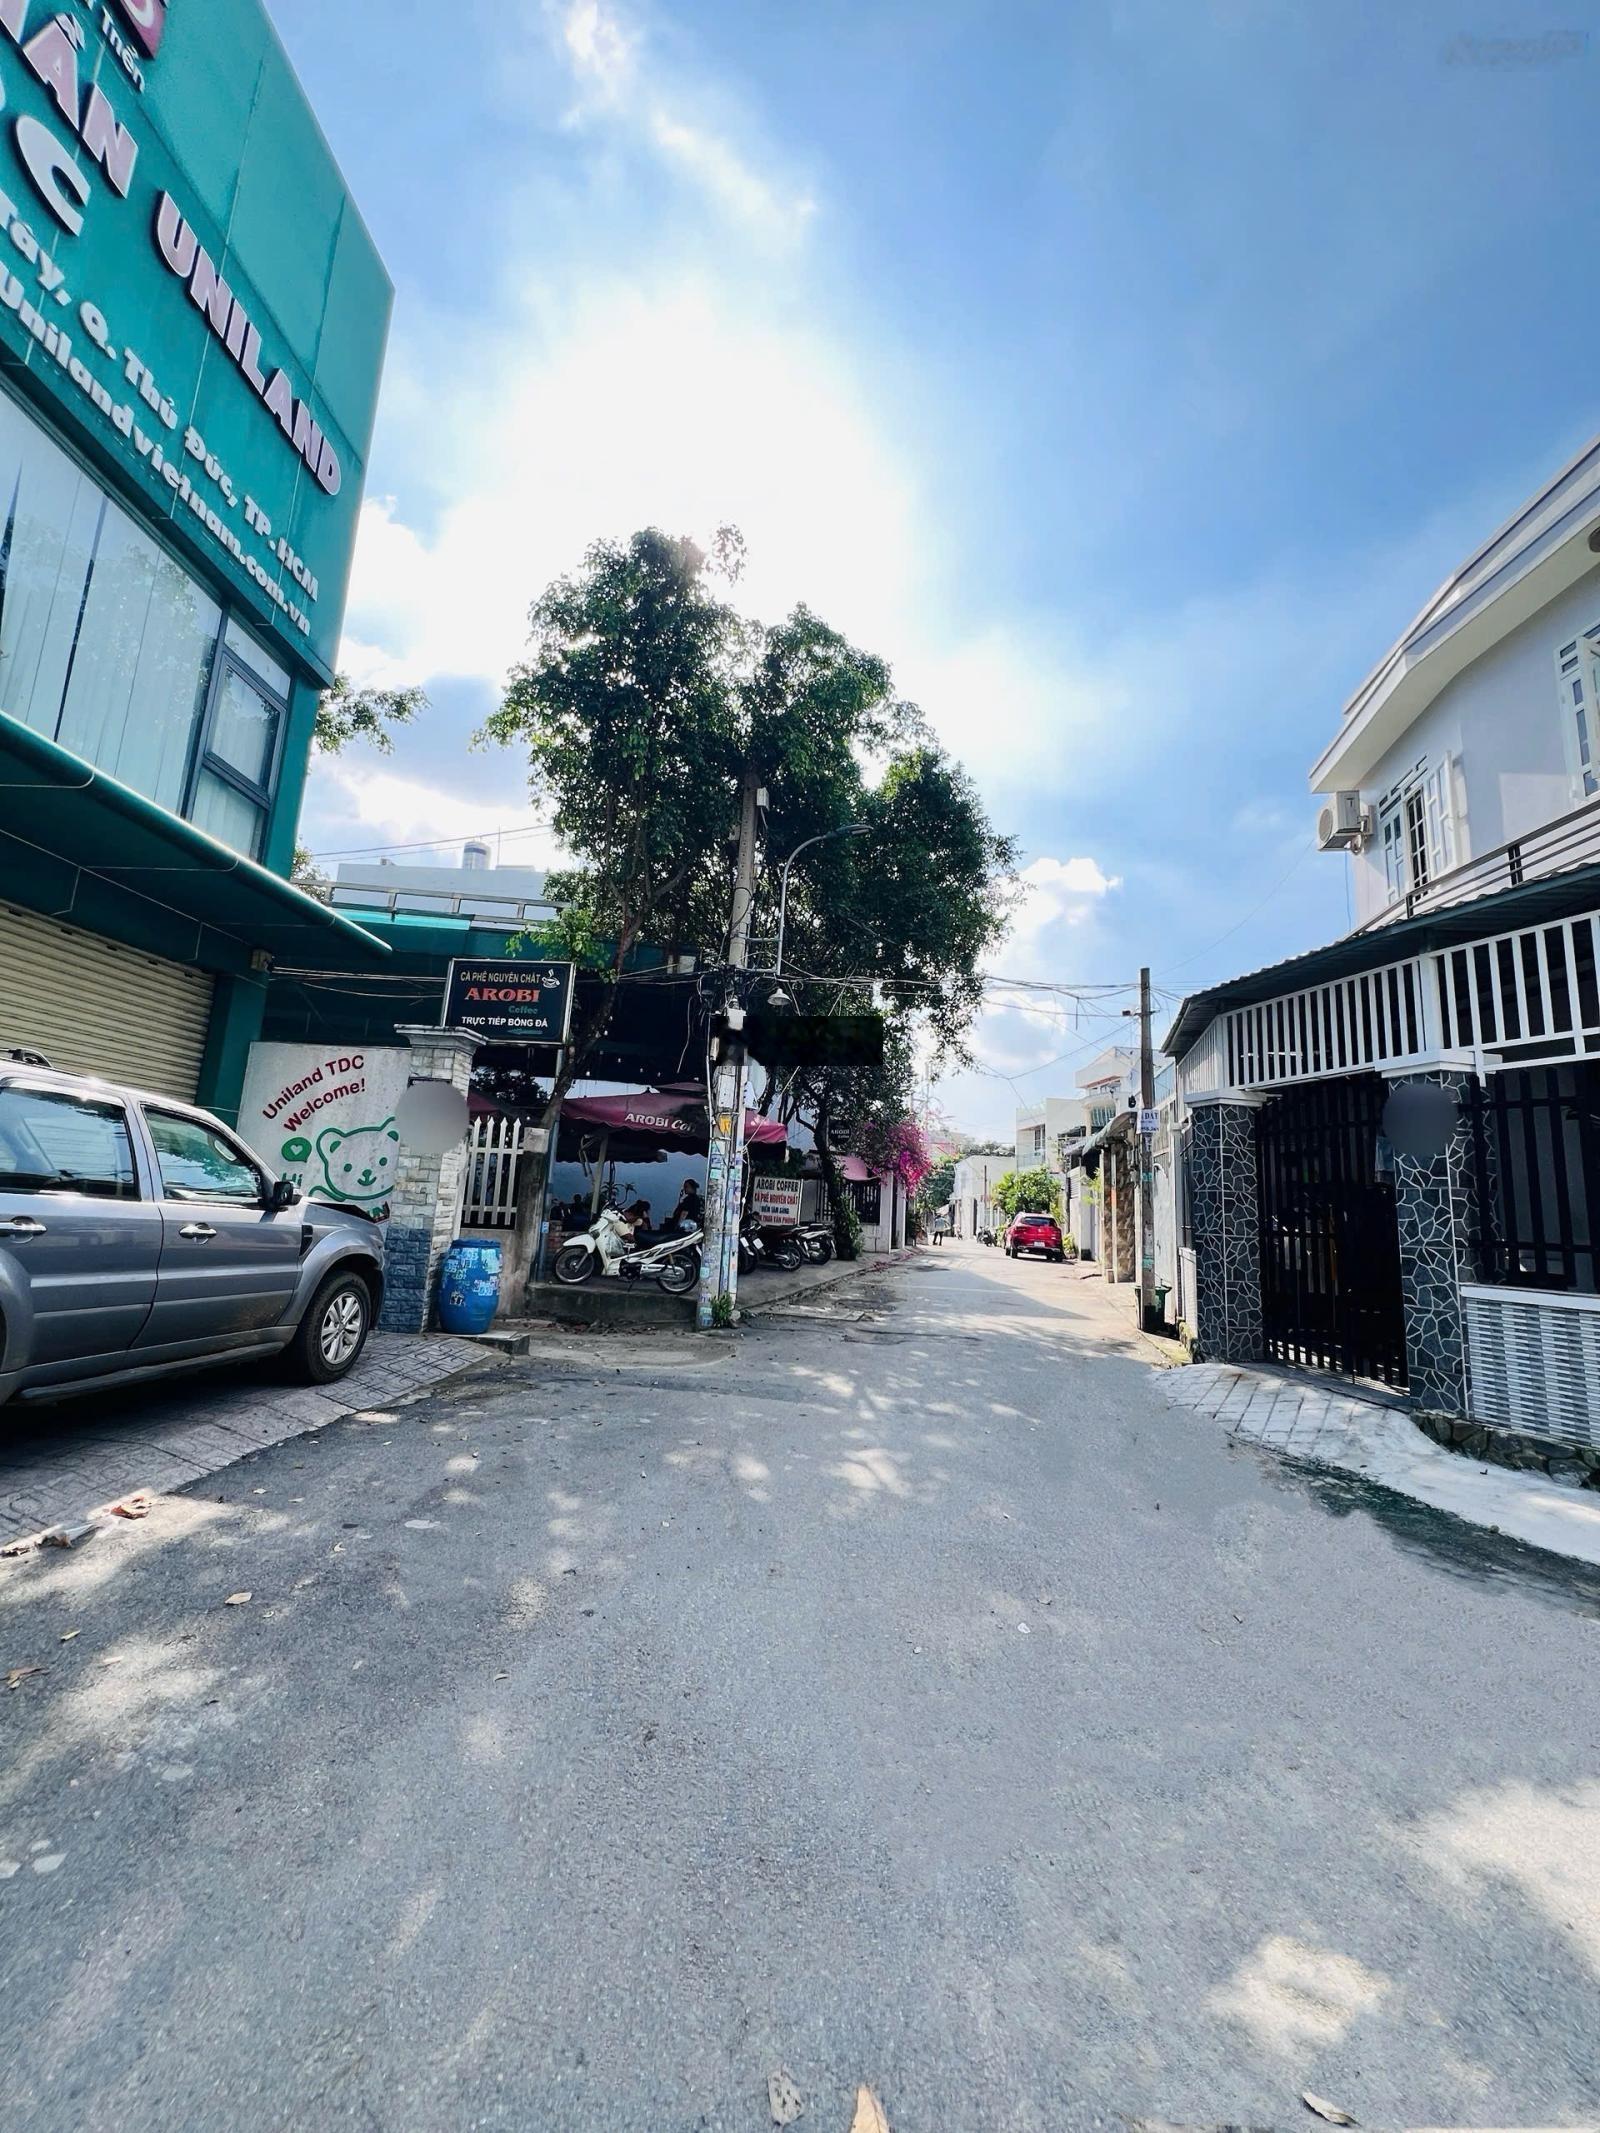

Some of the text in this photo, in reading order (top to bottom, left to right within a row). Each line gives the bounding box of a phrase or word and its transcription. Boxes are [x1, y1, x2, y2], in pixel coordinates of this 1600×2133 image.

[157, 190, 342, 497] UNILAND
[80, 301, 117, 360] Q.
[124, 346, 179, 430] Thủ
[184, 425, 239, 508] Đức,
[460, 970, 471, 981] CÀ
[472, 970, 487, 982] PHÊ
[488, 971, 518, 983] NGUYÊN
[464, 987, 540, 1003] AROBI
[508, 1005, 538, 1015] Coffee
[461, 1016, 486, 1027] TRỰC
[508, 1017, 533, 1027] BÓNG
[535, 1017, 548, 1028] ĐÁ
[262, 1054, 365, 1120] Uniland TDC
[283, 1077, 366, 1132] Welcome!
[624, 1112, 669, 1128] AROBI
[776, 1180, 799, 1192] COFFEE
